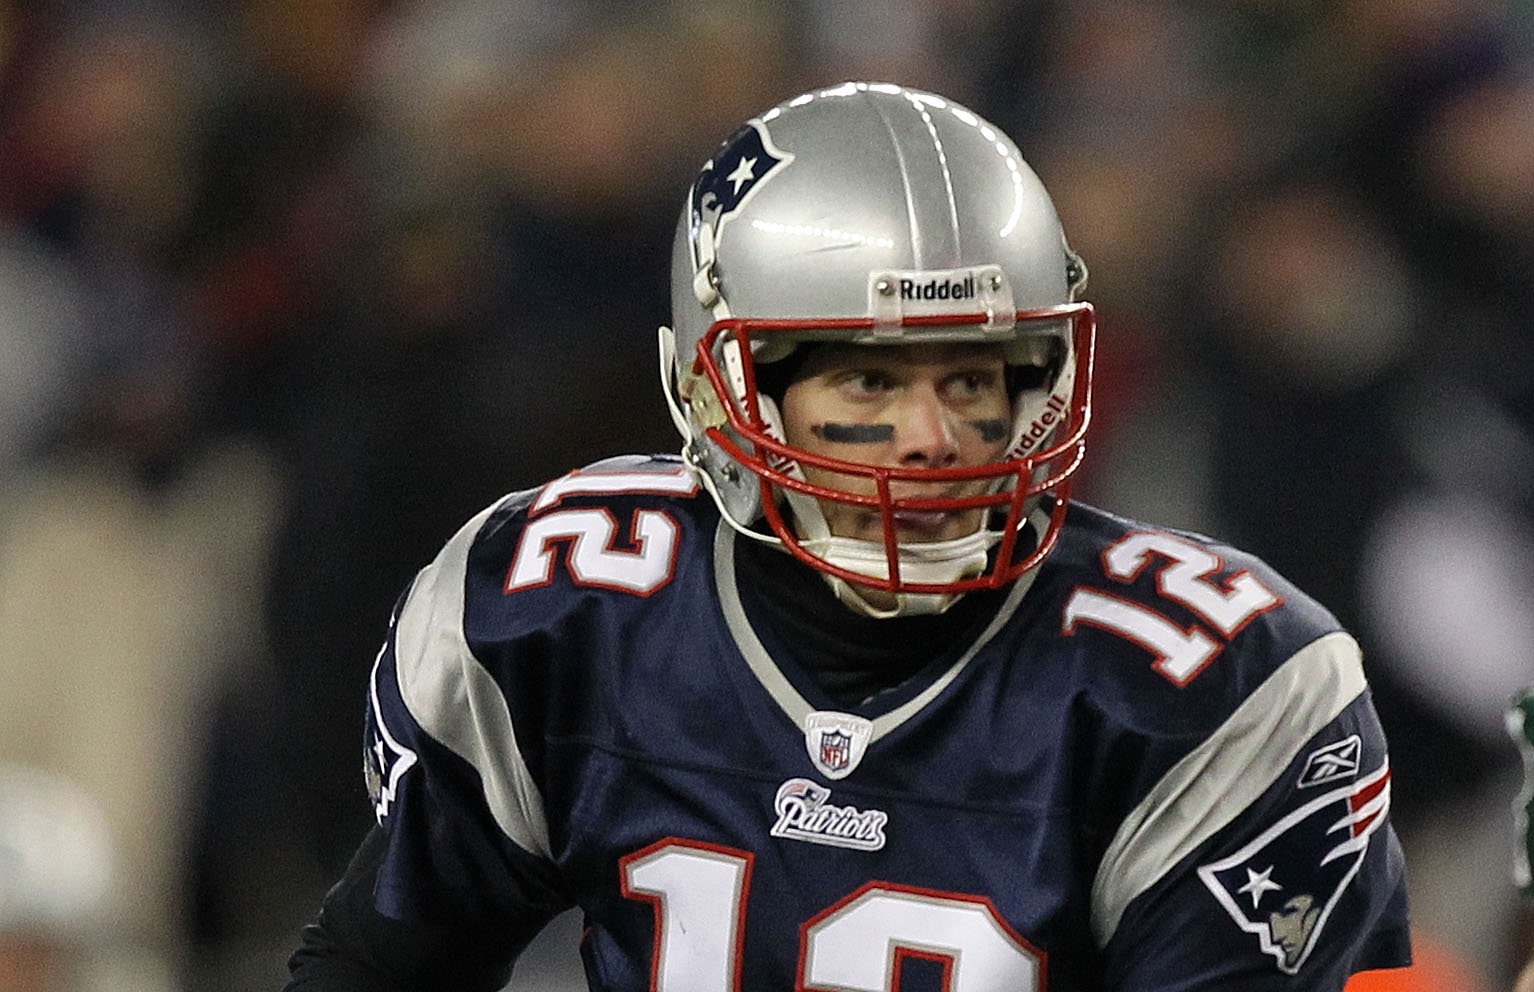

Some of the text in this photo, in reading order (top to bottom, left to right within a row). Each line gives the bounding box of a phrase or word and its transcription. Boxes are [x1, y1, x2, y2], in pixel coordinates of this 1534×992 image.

[900, 271, 974, 300] Riddell
[1006, 394, 1066, 460] iddell
[505, 469, 700, 597] 12
[1062, 529, 1284, 687] 12
[775, 796, 886, 842] Patriots
